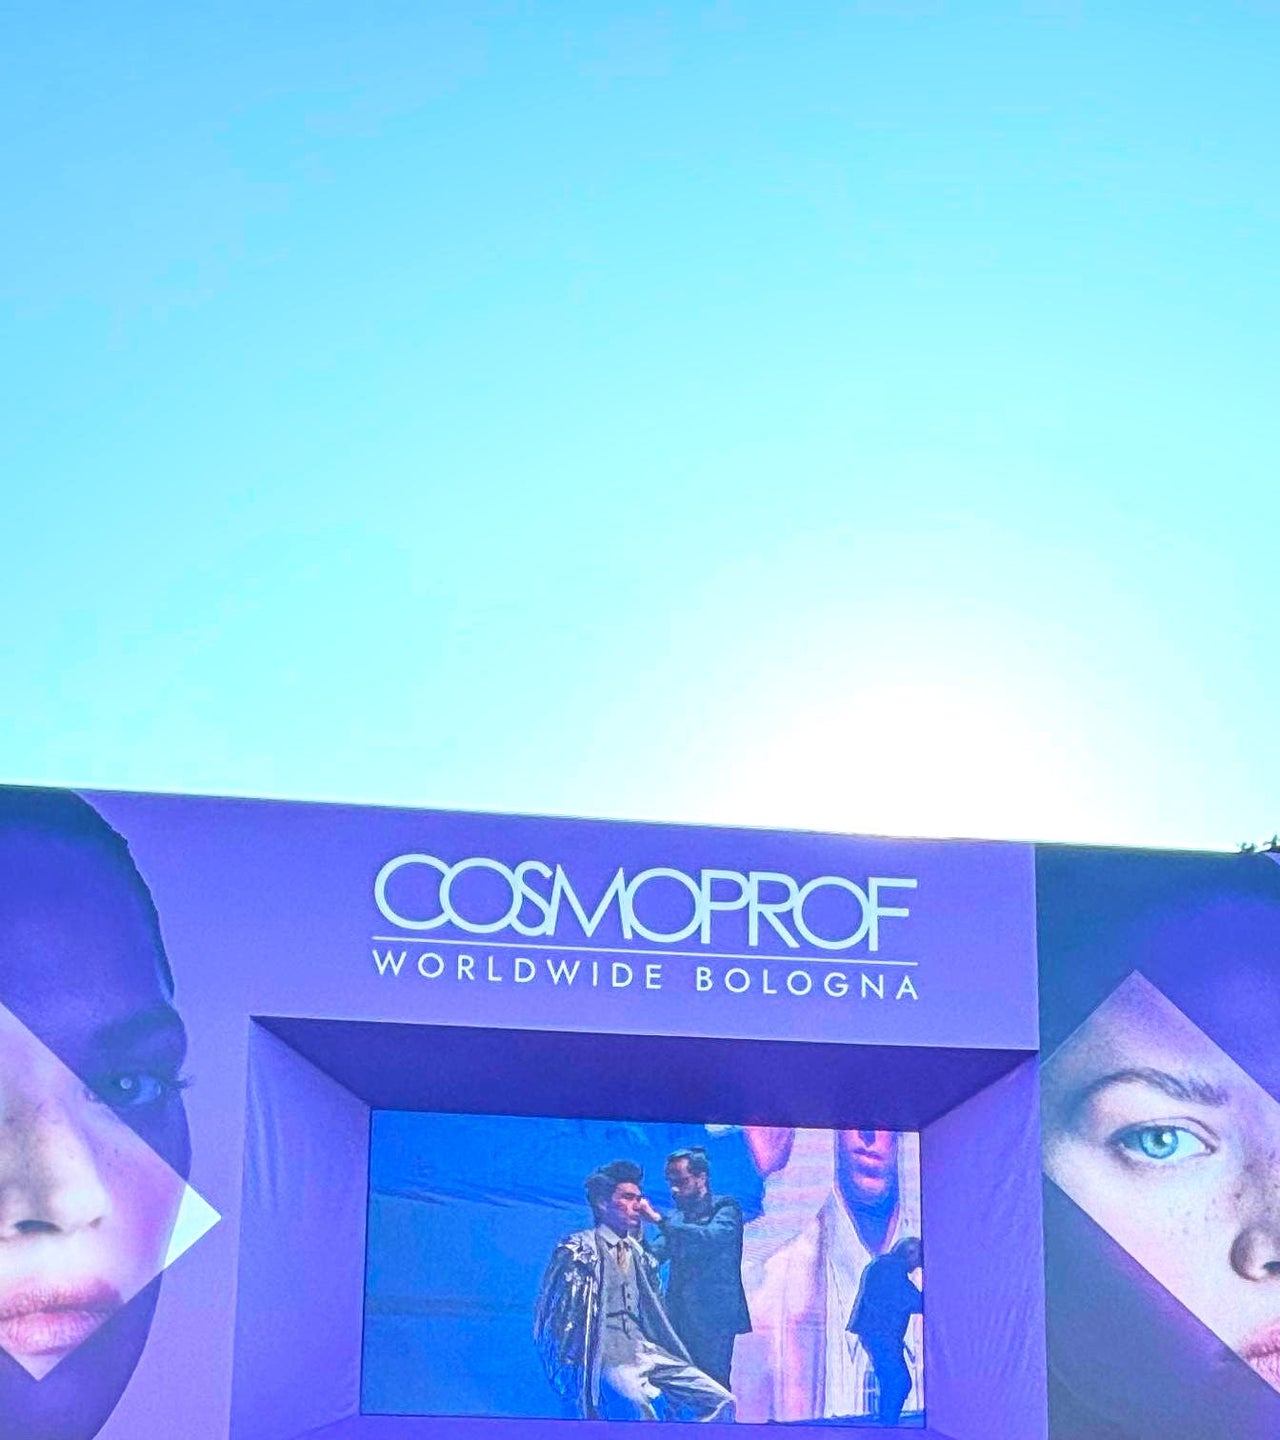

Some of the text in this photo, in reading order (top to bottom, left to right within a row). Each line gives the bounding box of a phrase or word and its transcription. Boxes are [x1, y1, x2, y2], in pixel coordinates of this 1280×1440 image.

[374, 853, 918, 952] COSMOPROF
[372, 949, 919, 1001] WORLDWIDE BOLOGNA
